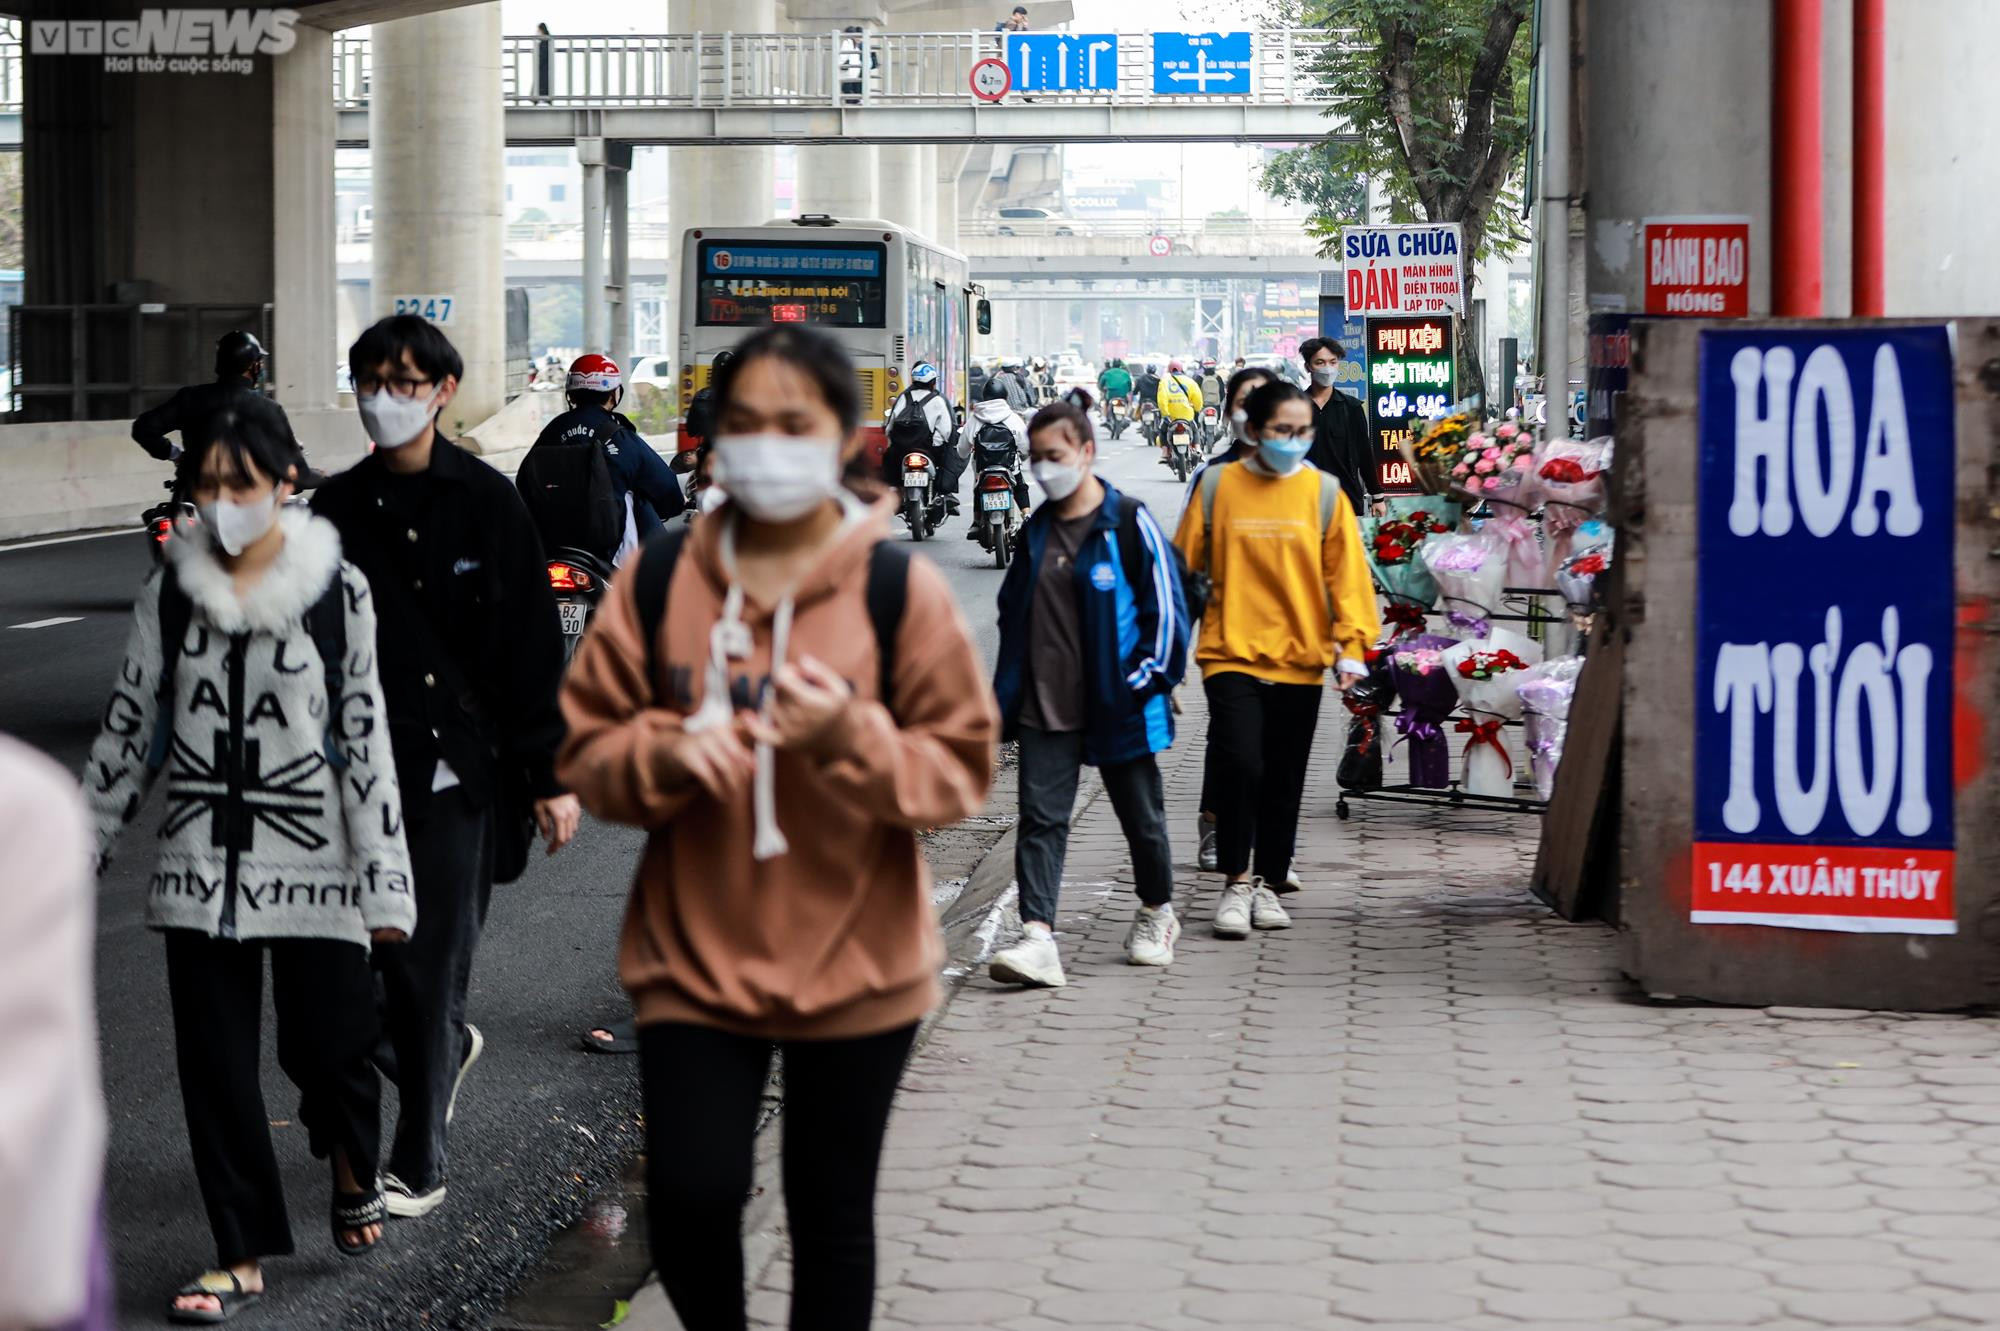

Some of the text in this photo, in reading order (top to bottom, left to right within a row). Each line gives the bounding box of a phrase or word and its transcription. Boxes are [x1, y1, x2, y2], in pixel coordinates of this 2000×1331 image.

[1398, 228, 1458, 256] CHỮA
[715, 253, 729, 267] 16
[1651, 227, 1744, 287] BÁNH BAO
[1347, 260, 1399, 310] DÁN
[1404, 281, 1459, 297] ĐIỆN THOẠI
[1404, 299, 1444, 311] LAP TOP
[1666, 288, 1726, 312] NÓNG
[1378, 323, 1442, 355] PHỤ KIỆN
[1372, 357, 1405, 388] ĐIỆN
[1416, 394, 1446, 420] SẠC
[1728, 342, 1923, 538] HOA
[1382, 462, 1412, 483] LOA
[1713, 604, 1933, 837] TƯƠI
[1708, 857, 1941, 901] 144 XUÂN THỦY
